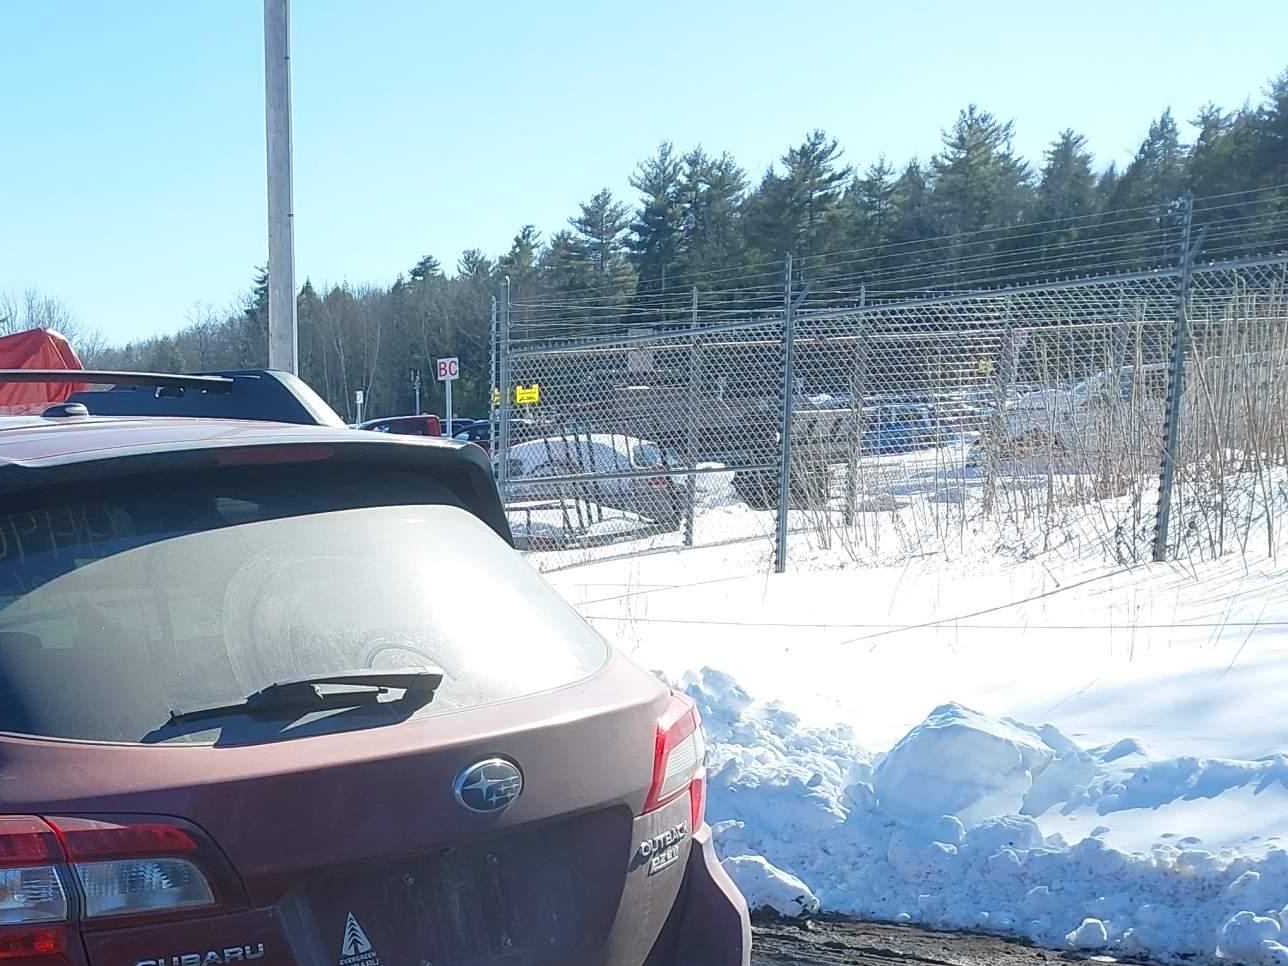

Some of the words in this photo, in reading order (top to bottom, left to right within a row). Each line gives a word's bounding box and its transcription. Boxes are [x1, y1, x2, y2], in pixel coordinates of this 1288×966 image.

[438, 361, 458, 377] BC
[640, 821, 688, 857] OUTBACK
[339, 951, 377, 966] EVERGREEN
